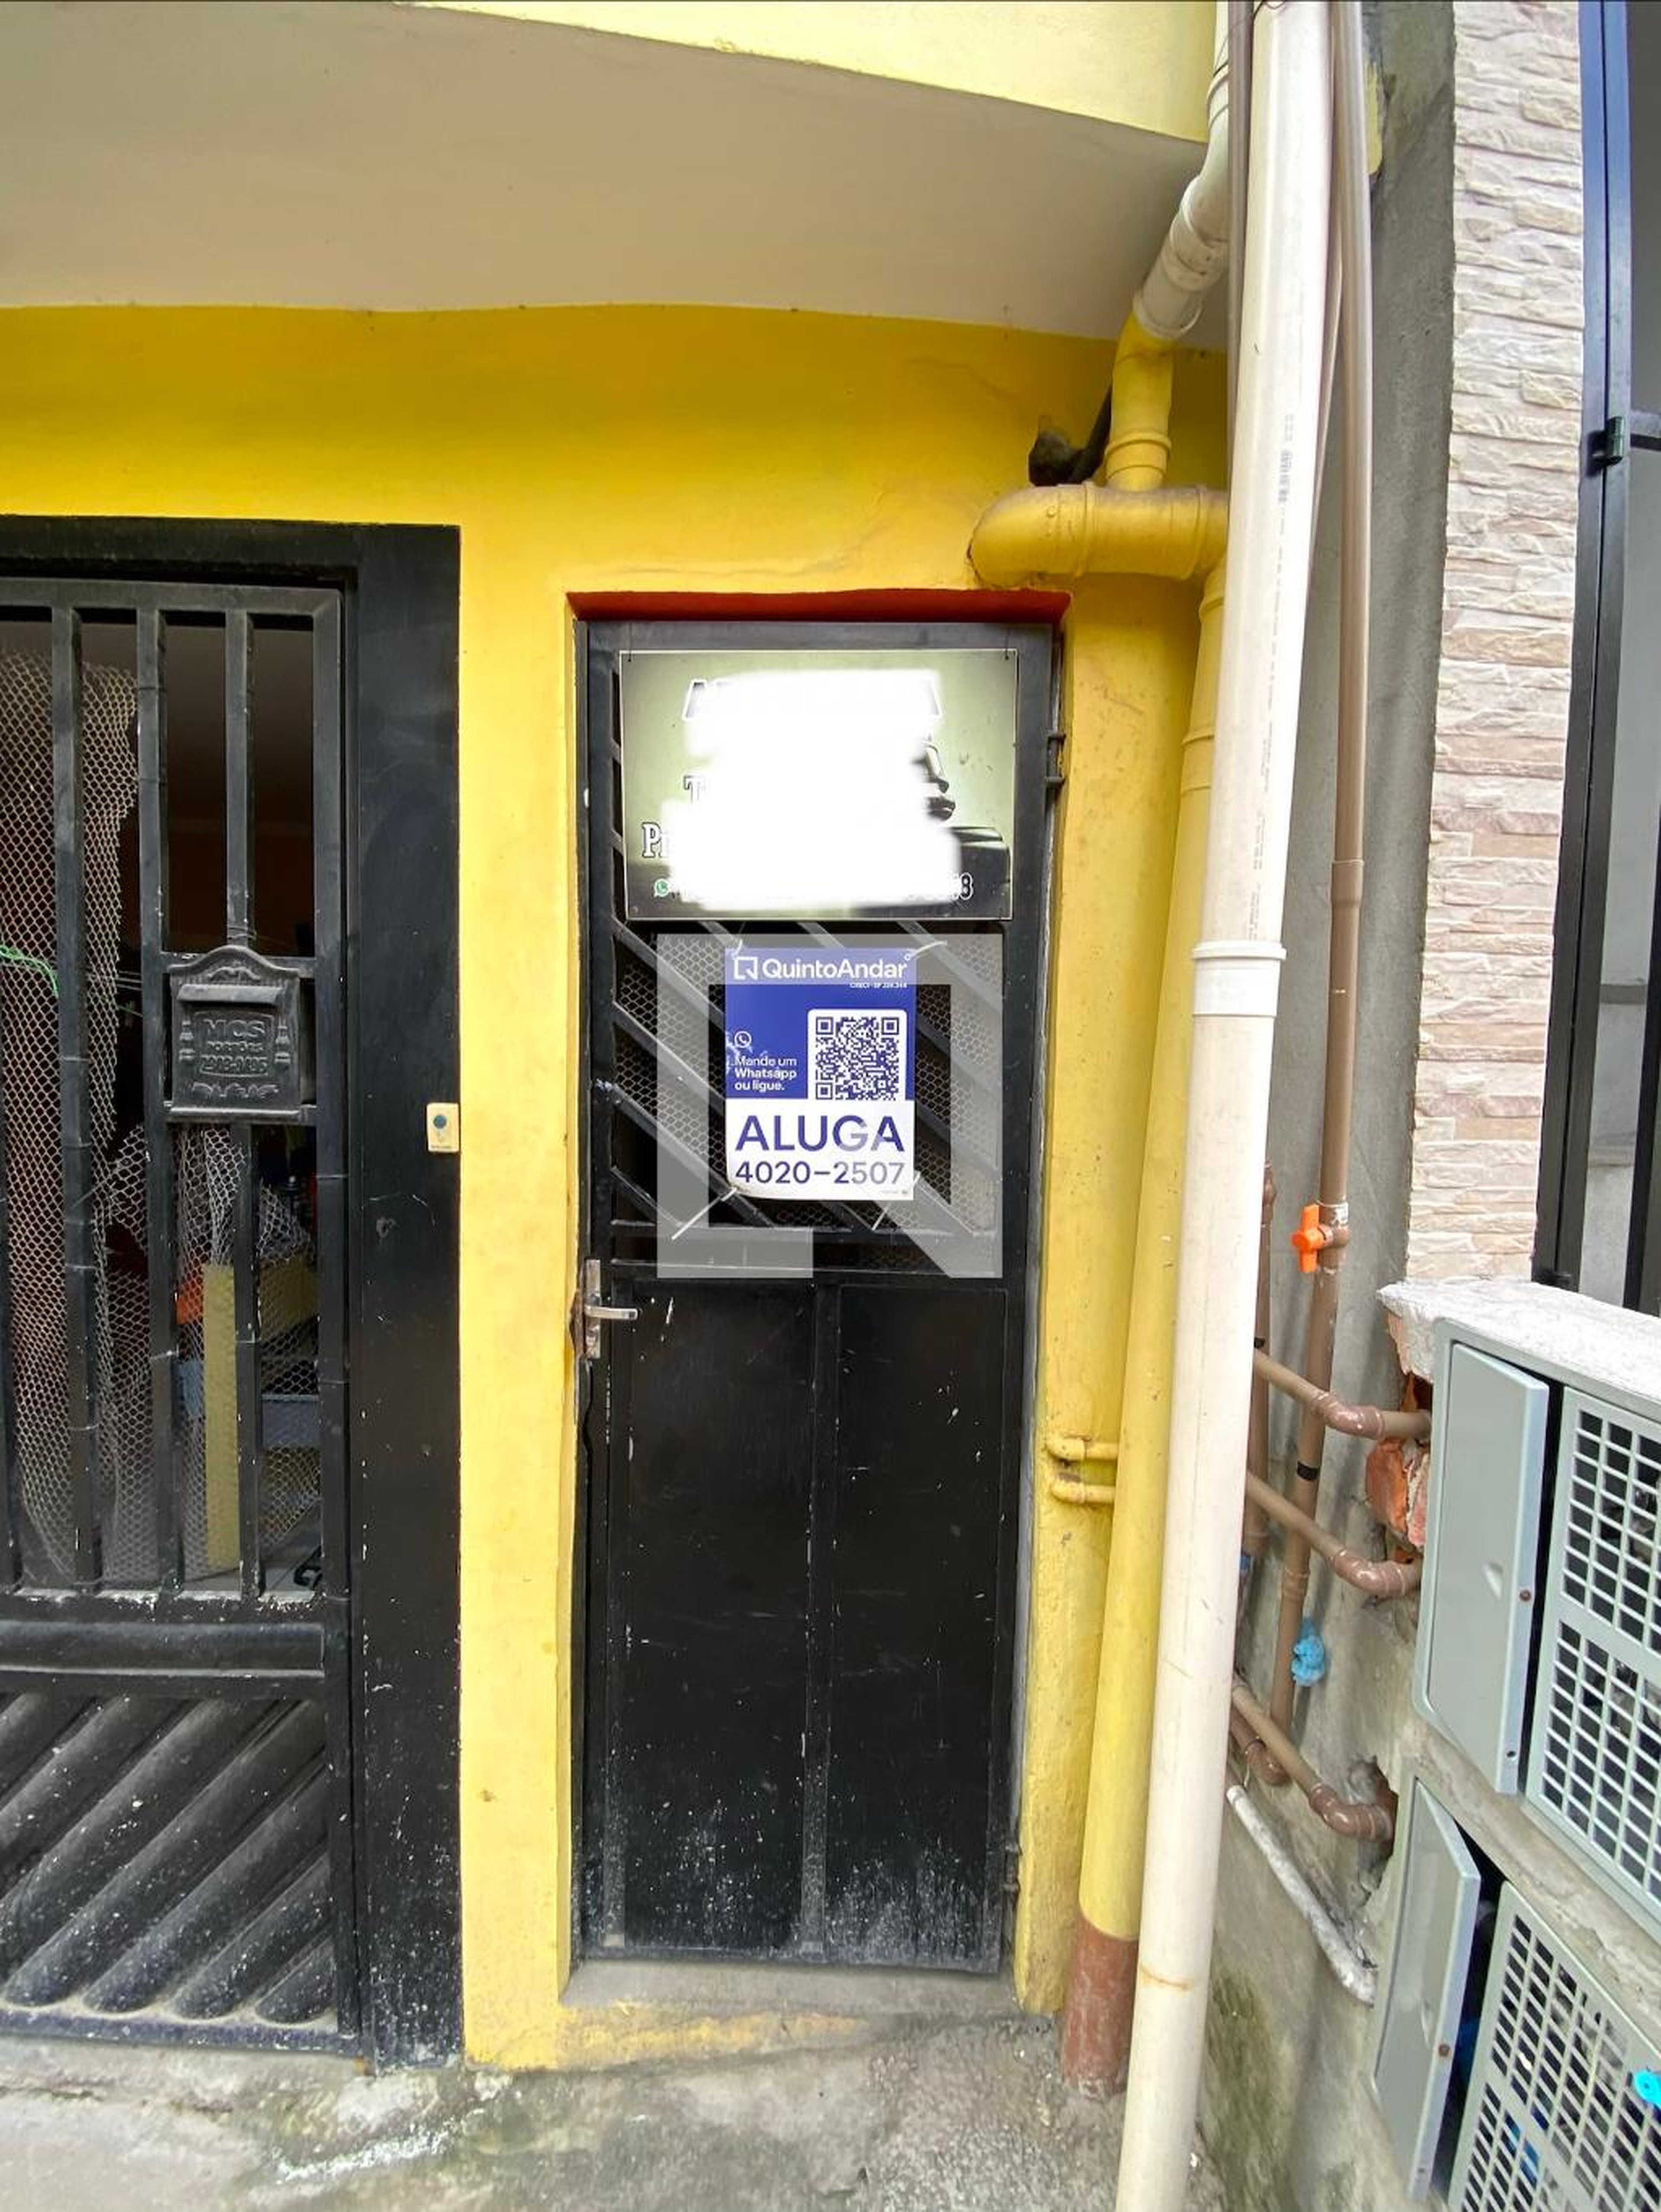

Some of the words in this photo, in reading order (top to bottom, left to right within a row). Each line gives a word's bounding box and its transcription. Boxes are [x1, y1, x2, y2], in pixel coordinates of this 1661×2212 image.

[763, 959, 907, 979] QuintoAndar
[735, 1055, 776, 1066] Mande
[735, 1082, 750, 1090] ou
[752, 1080, 784, 1092] ligue.
[735, 1115, 905, 1152] ALUGA
[735, 1160, 905, 1184] 4020-2507
